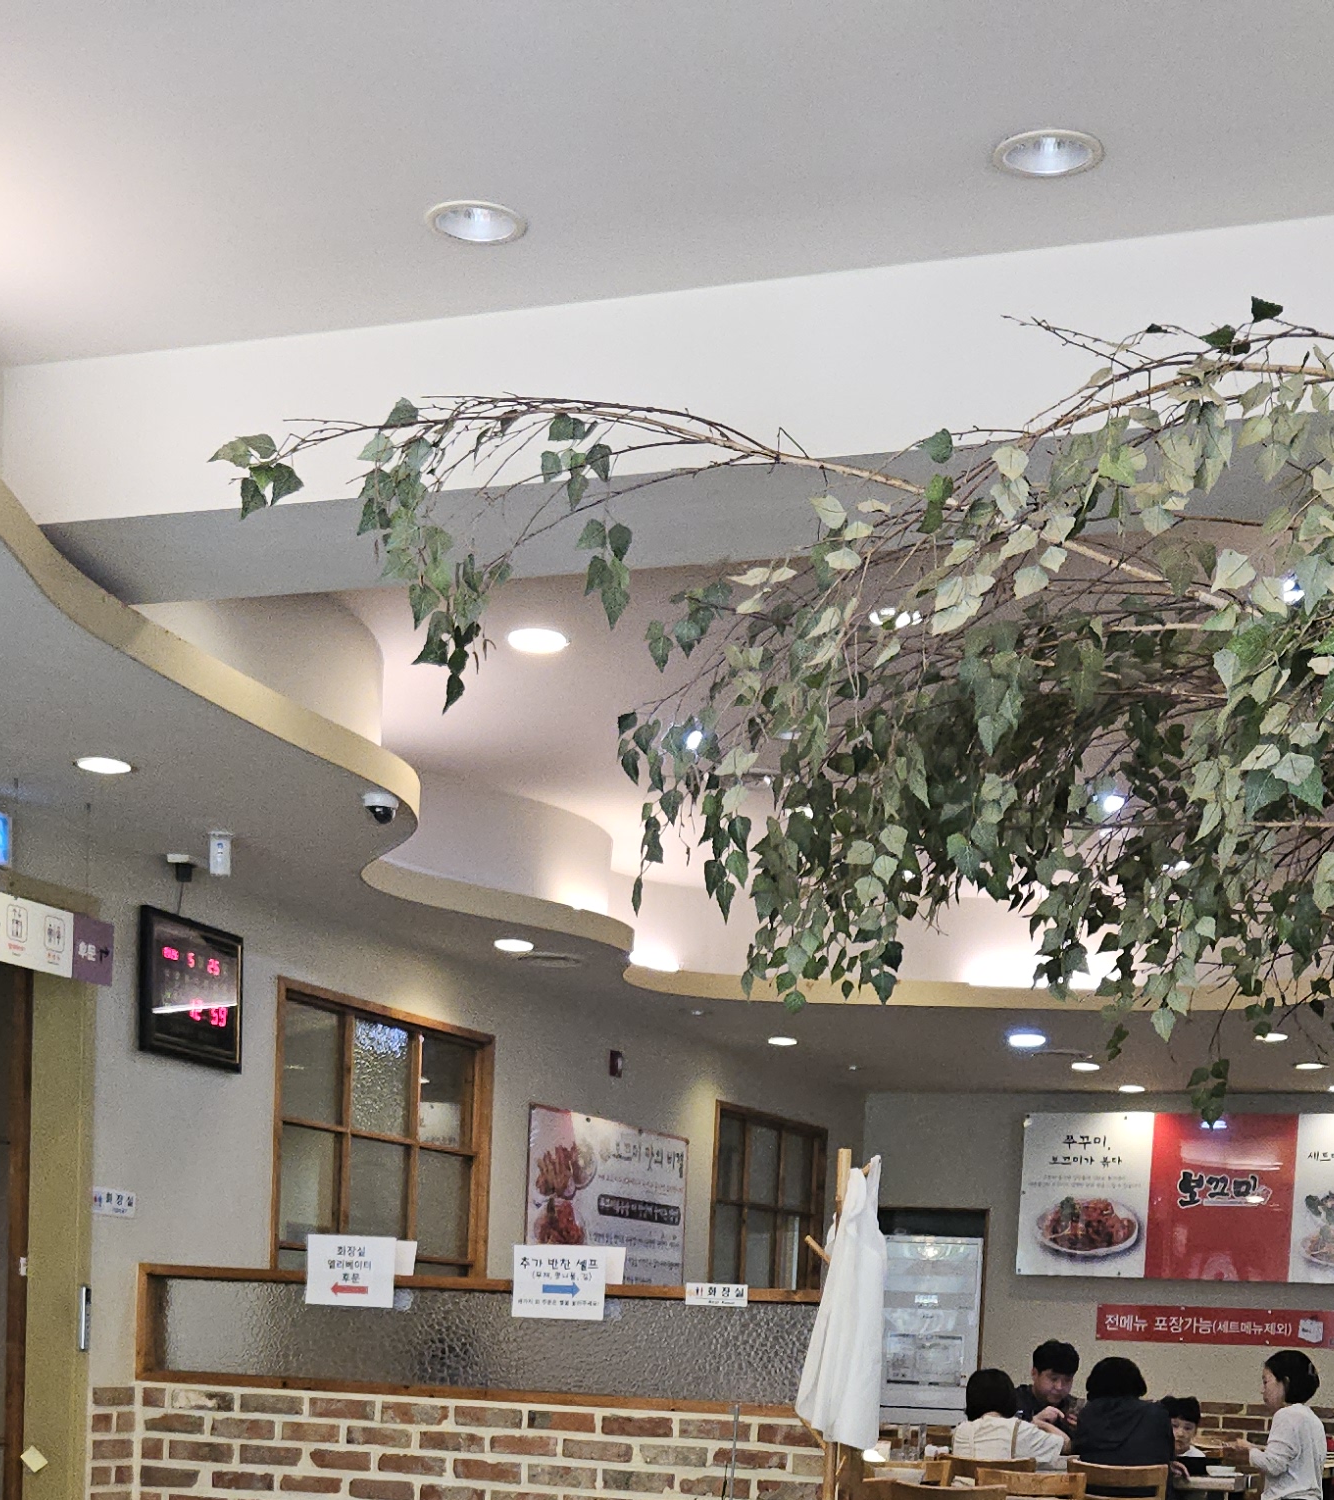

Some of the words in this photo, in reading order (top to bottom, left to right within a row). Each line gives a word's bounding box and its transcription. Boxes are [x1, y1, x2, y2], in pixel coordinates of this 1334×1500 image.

[105, 1191, 134, 1207] 화장실
[336, 1245, 366, 1257] 화장실
[327, 1259, 372, 1271] 엘리베이터
[520, 1256, 543, 1270] 추가
[547, 1258, 571, 1271] 반찬
[575, 1258, 599, 1272] 셀프
[342, 1273, 360, 1284] 후문
[708, 1286, 744, 1298] 화장실
[1104, 1313, 1149, 1333] 전메뉴
